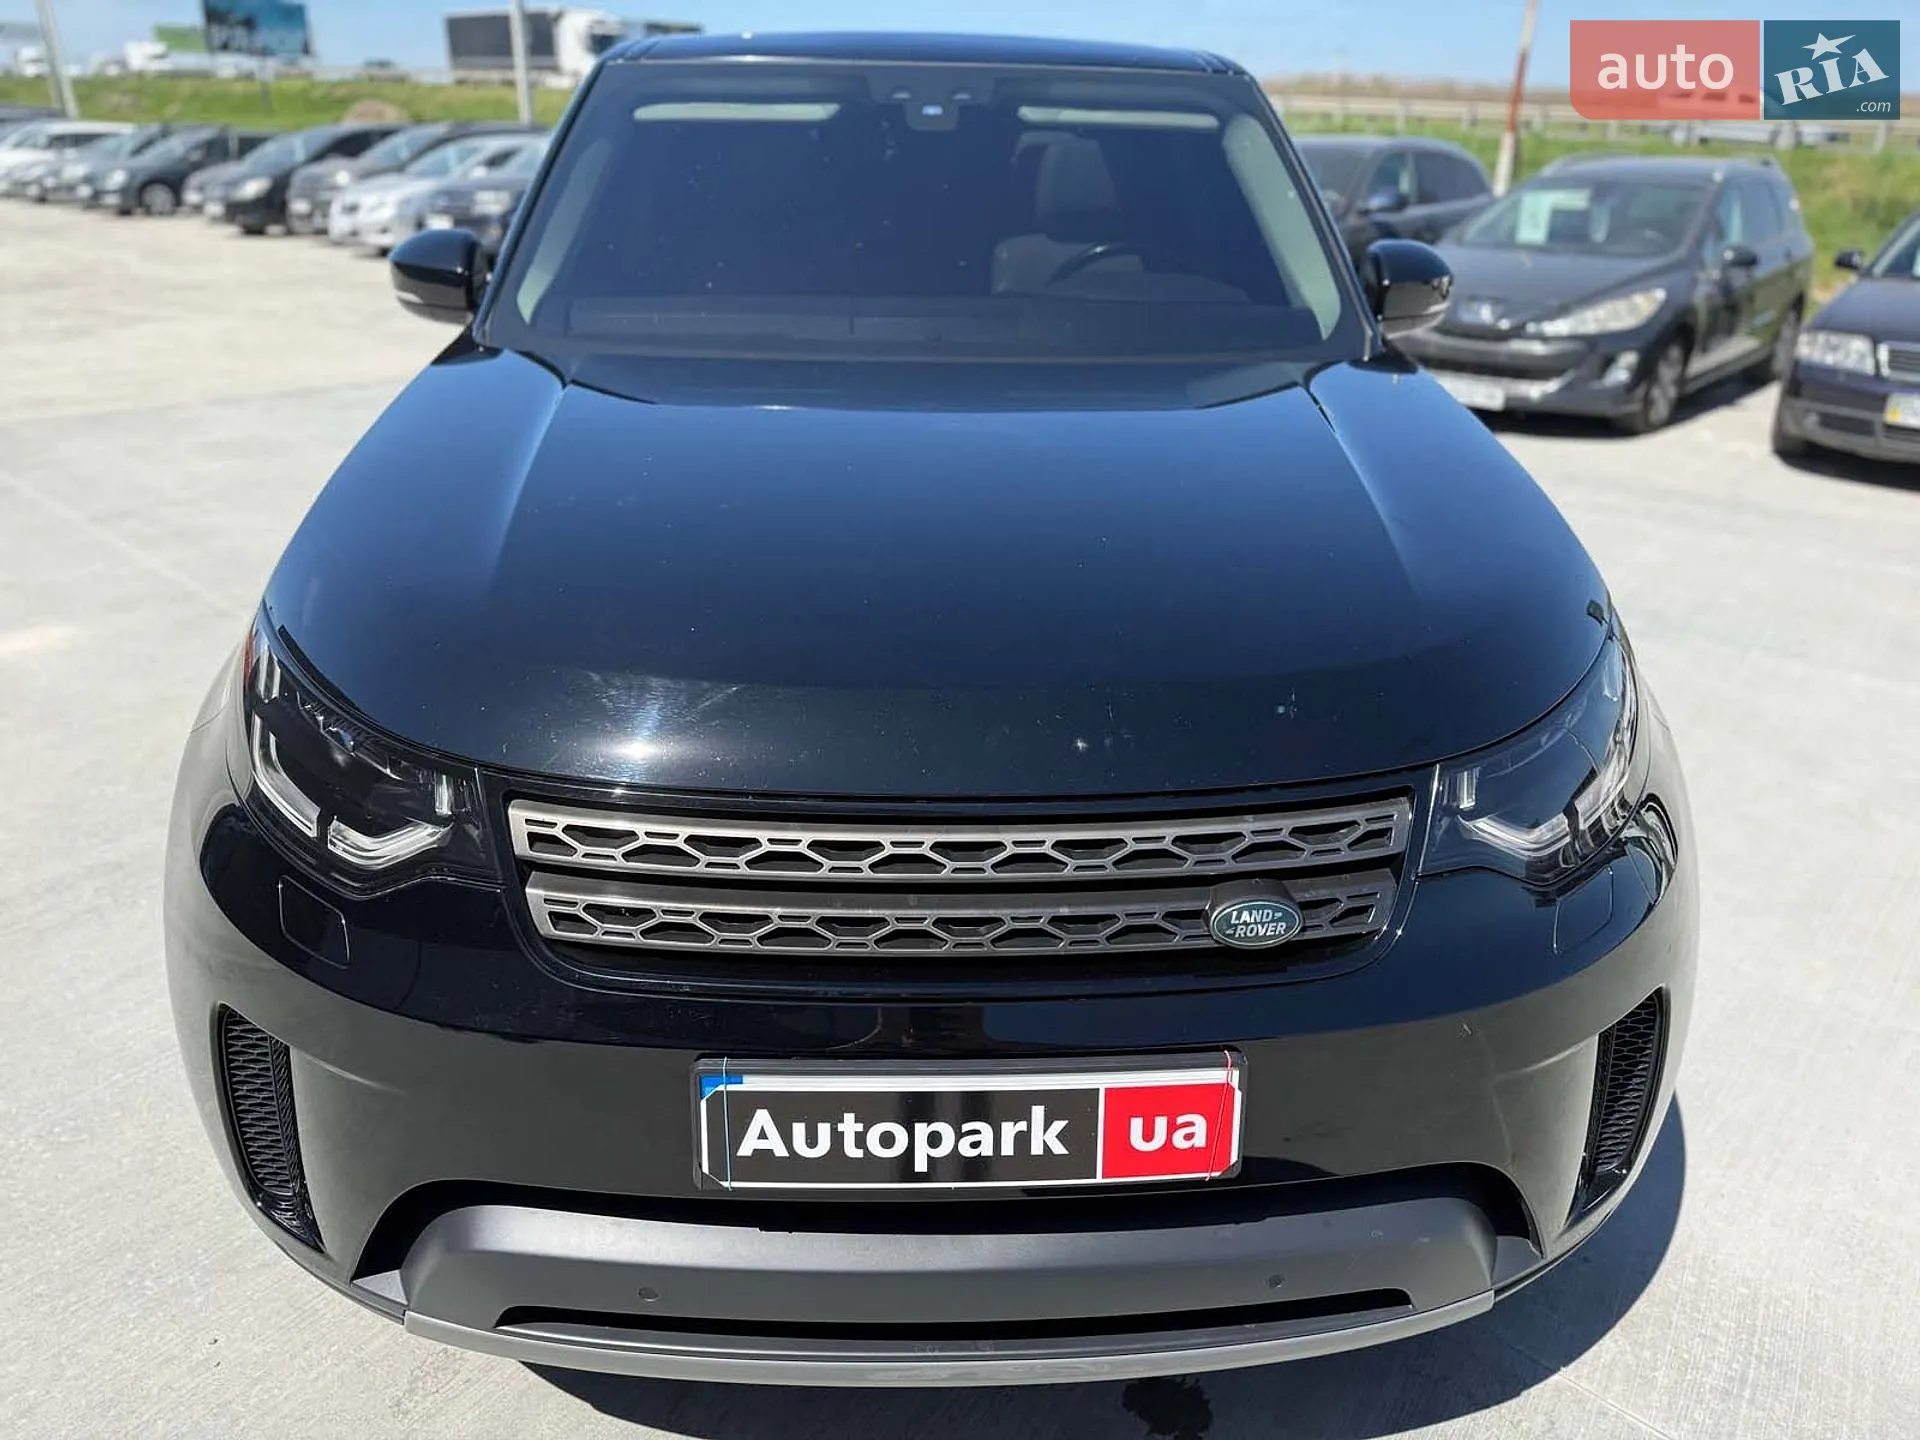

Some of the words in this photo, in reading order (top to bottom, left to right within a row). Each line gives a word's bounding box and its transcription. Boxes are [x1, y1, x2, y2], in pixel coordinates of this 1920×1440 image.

[1231, 910, 1273, 924] LAND
[1234, 922, 1287, 938] ROVER
[736, 1105, 1070, 1173] Autopark
[1129, 1112, 1208, 1152] ua
